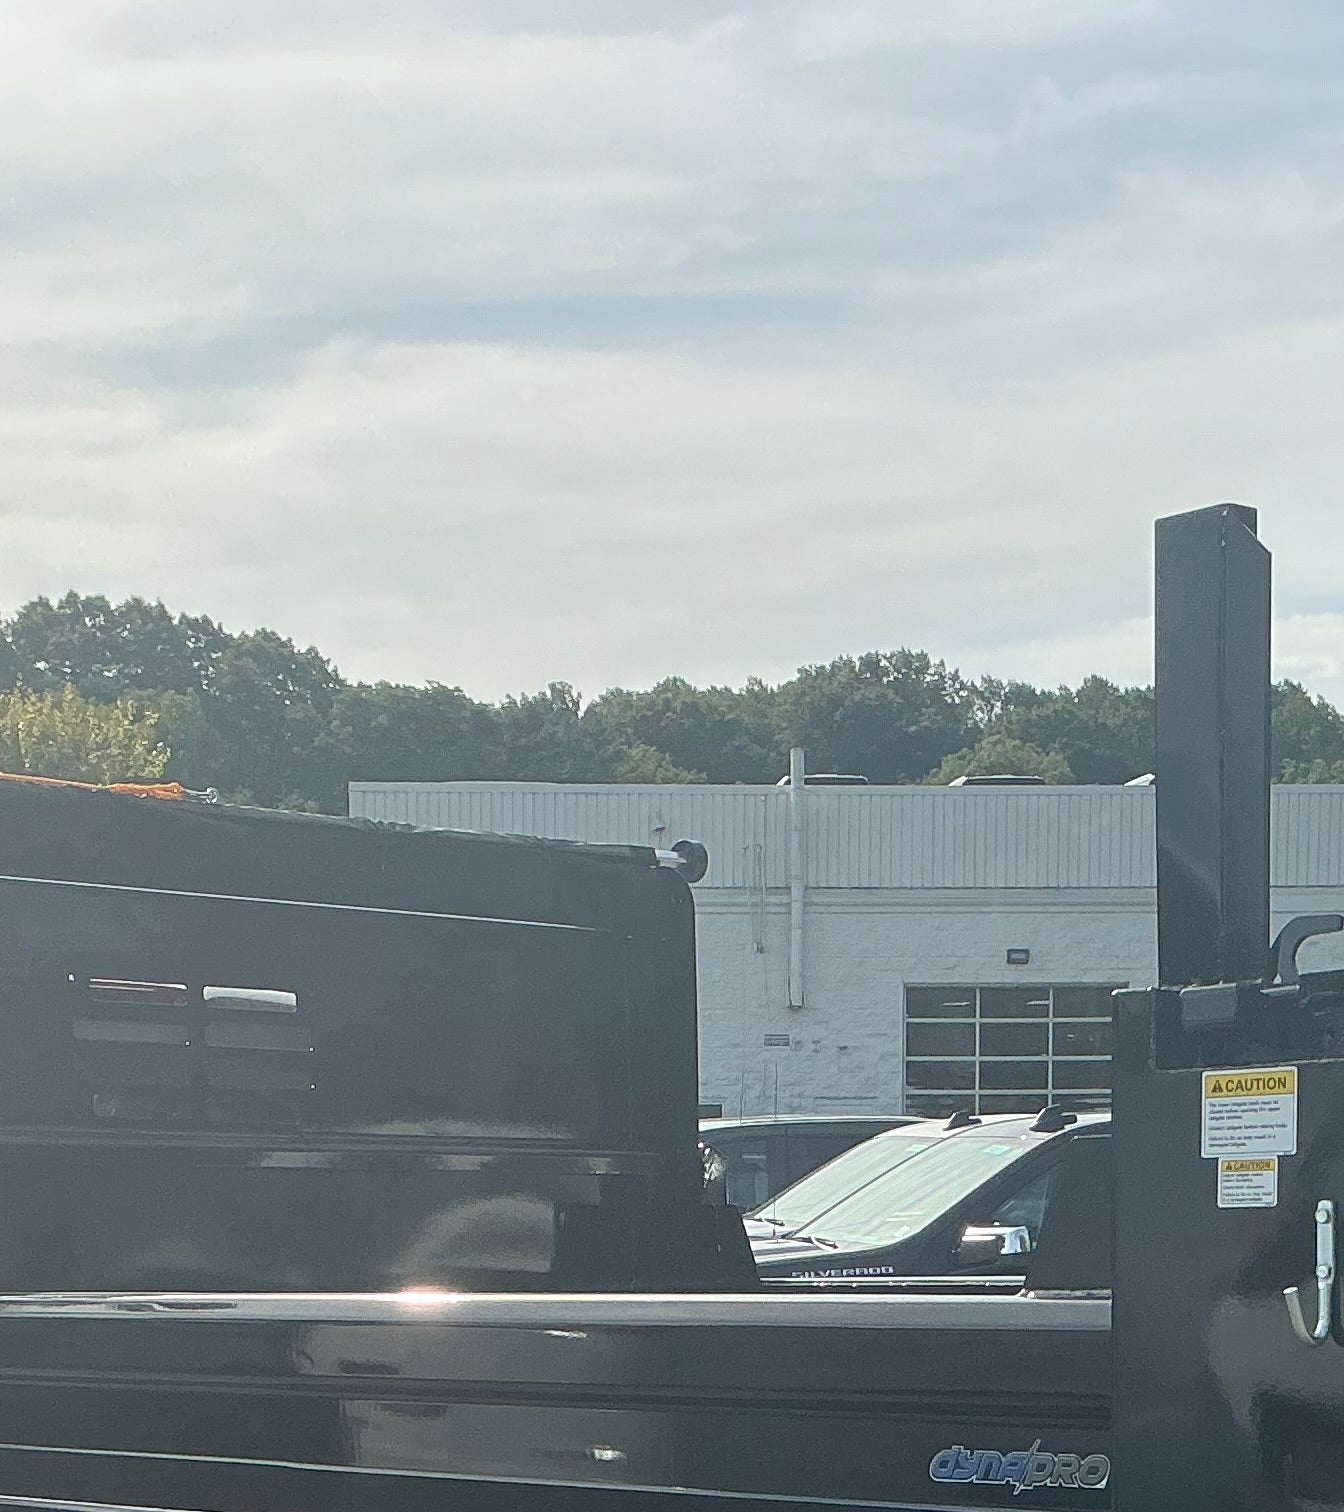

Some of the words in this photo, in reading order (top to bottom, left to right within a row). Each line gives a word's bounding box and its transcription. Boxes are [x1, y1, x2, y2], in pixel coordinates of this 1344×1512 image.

[1225, 1076, 1287, 1092] CAUTION
[1234, 1161, 1270, 1170] CAUTION
[791, 1265, 895, 1279] SILVERADO
